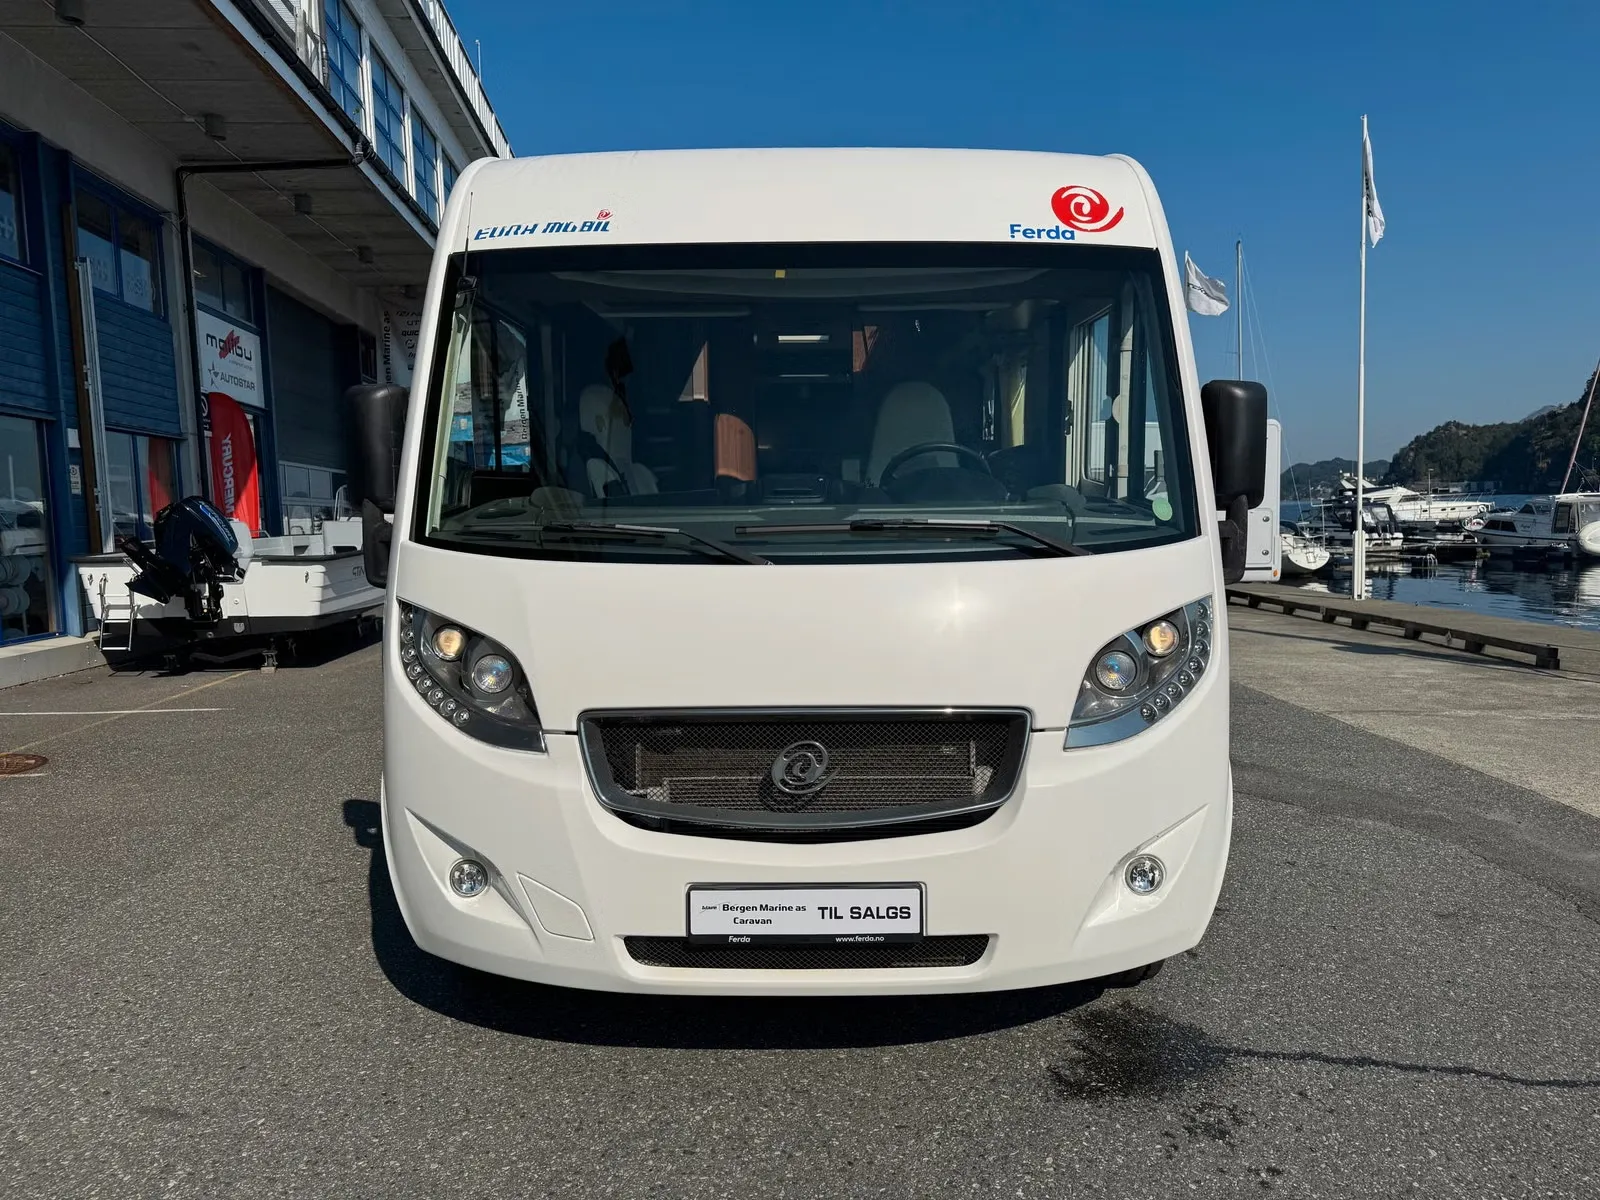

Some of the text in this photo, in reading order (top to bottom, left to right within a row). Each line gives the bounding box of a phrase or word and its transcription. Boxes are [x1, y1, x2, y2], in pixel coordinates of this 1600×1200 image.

[1010, 224, 1075, 240] Ferda
[220, 372, 256, 391] AUTOSTAR
[722, 903, 758, 914] Bergen
[759, 903, 794, 912] Marine
[795, 904, 807, 912] as
[818, 906, 911, 920] TIL SALGS
[733, 916, 772, 925] Caravan
[835, 935, 885, 943] www.ferda.no
